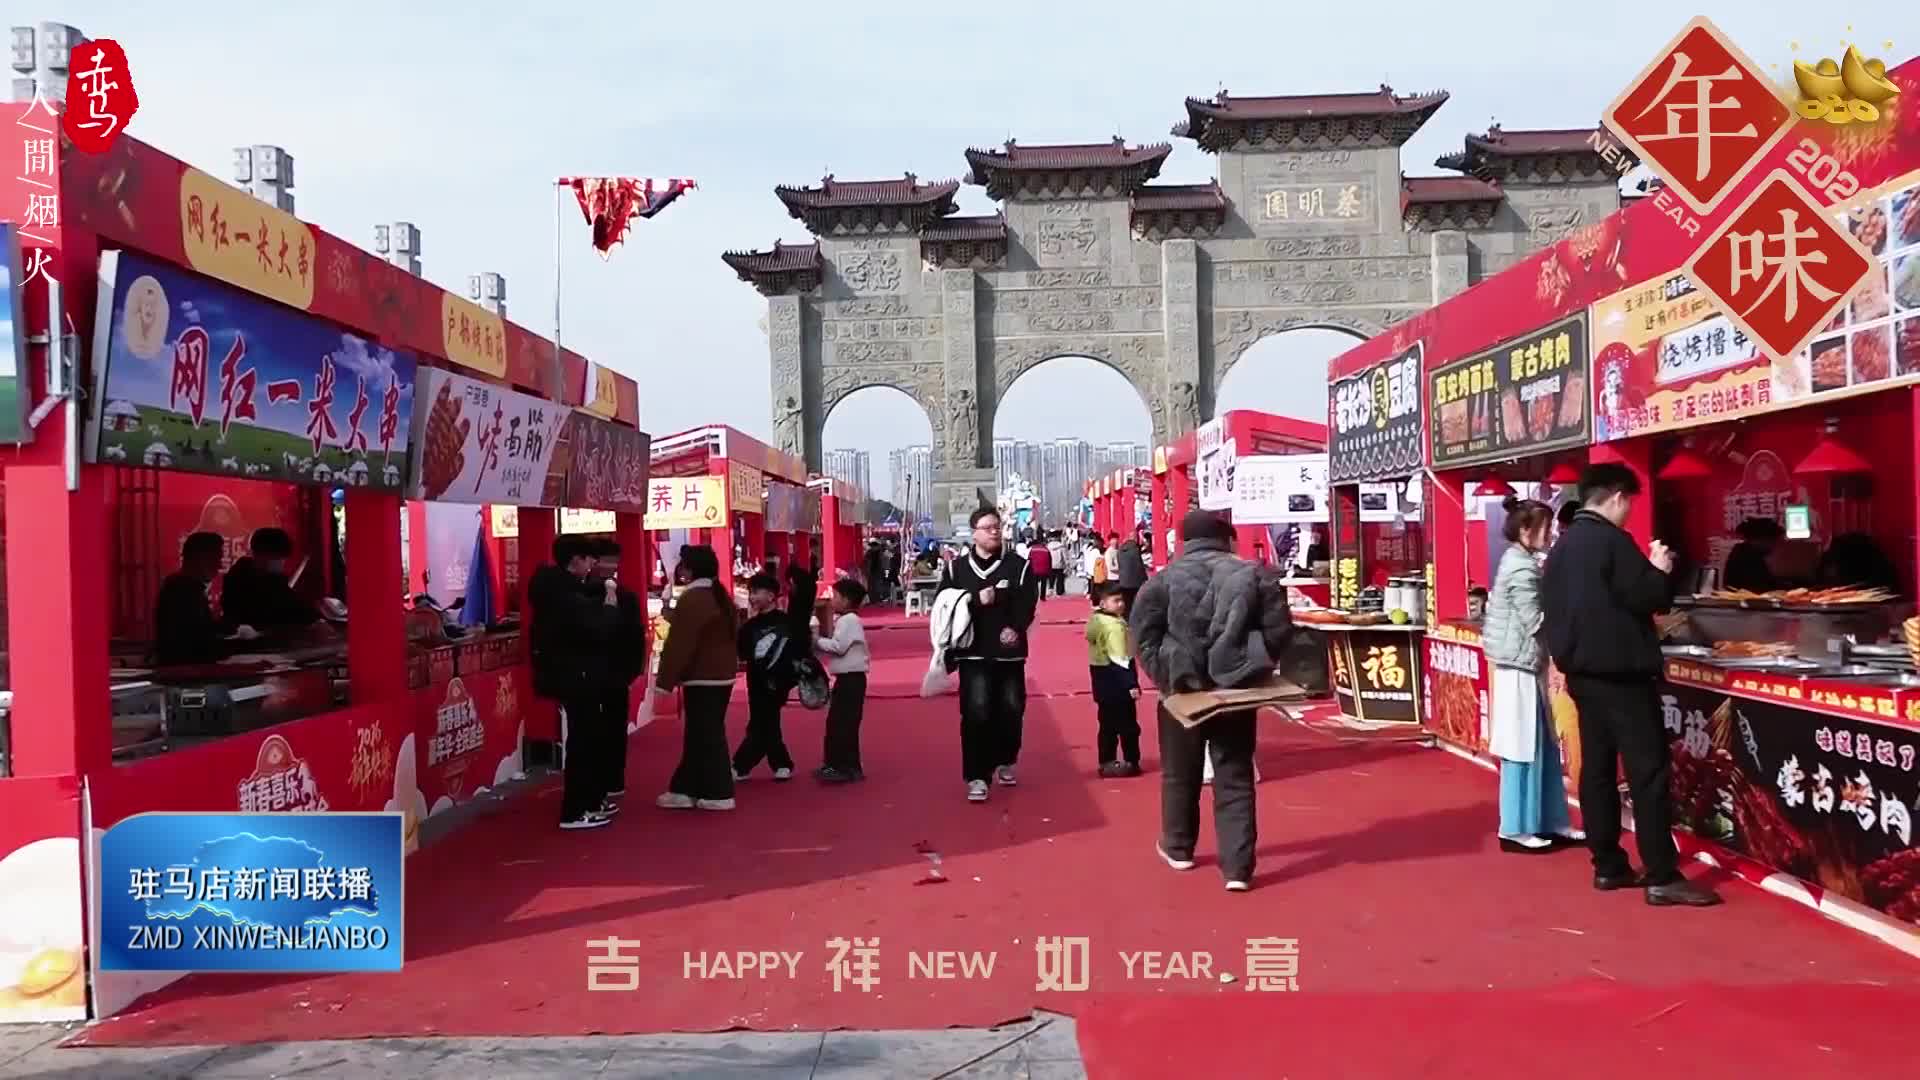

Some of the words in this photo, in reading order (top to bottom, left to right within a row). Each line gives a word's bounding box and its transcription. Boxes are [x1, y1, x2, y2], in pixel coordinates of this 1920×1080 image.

[187, 194, 309, 287] 网红一米大串
[1510, 332, 1570, 382] 蒙古烤肉
[169, 325, 403, 468] 网红一米大串
[1361, 646, 1405, 689] 福
[1661, 694, 1712, 760] 面筋
[239, 767, 300, 811] 新春喜乐
[1777, 753, 1912, 846] 蒙古烤肉
